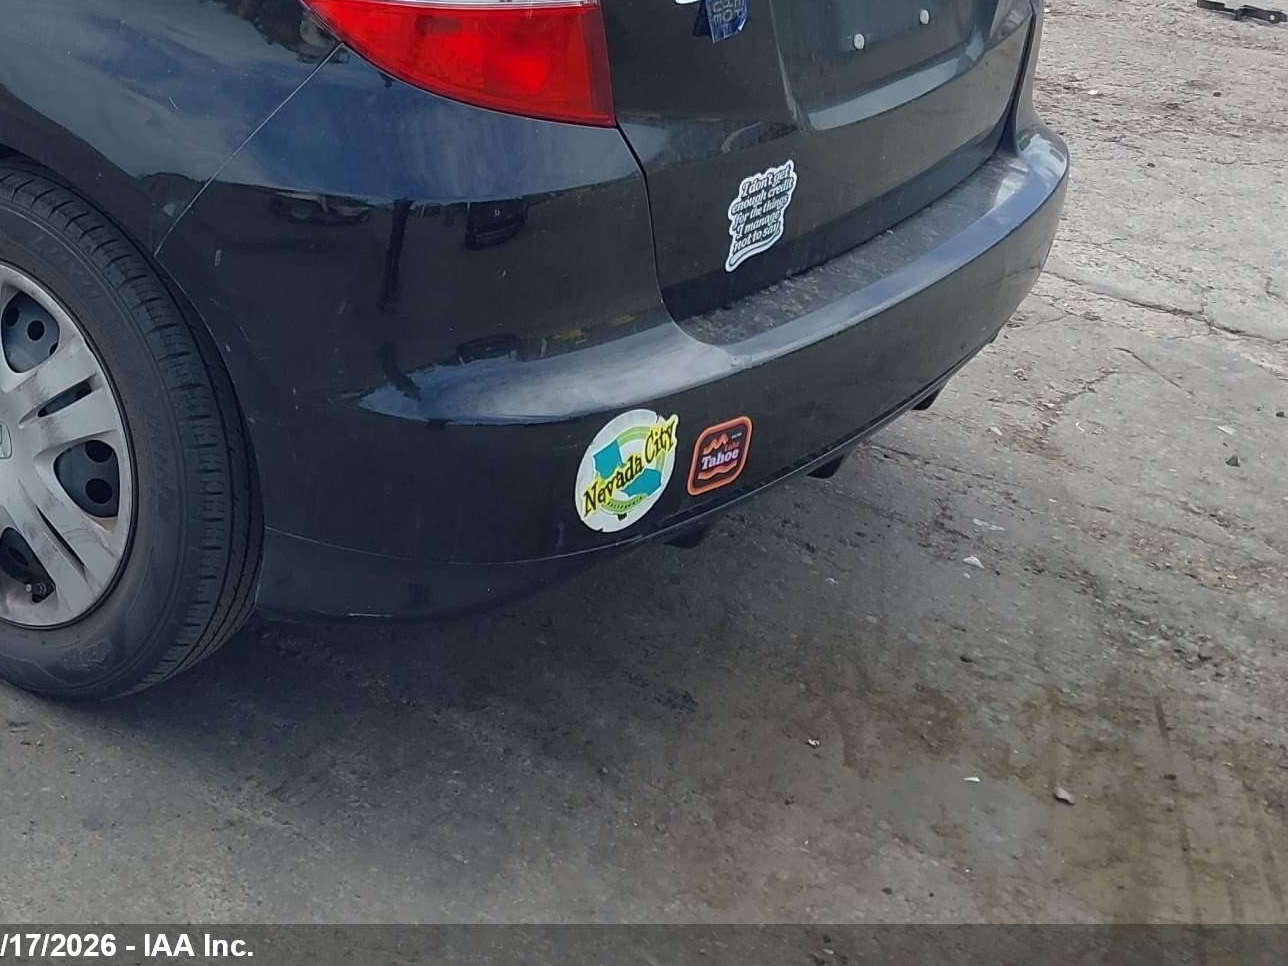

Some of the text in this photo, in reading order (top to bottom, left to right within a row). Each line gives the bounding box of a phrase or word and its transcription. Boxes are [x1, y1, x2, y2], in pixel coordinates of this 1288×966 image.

[750, 172, 774, 194] don't
[774, 165, 791, 187] get
[731, 177, 793, 214] enough credit
[733, 195, 788, 230] for the things
[745, 209, 781, 233] manage
[733, 234, 751, 253] not
[752, 230, 762, 241] to
[583, 421, 676, 518] Nevada City
[701, 449, 740, 470] Tahoe
